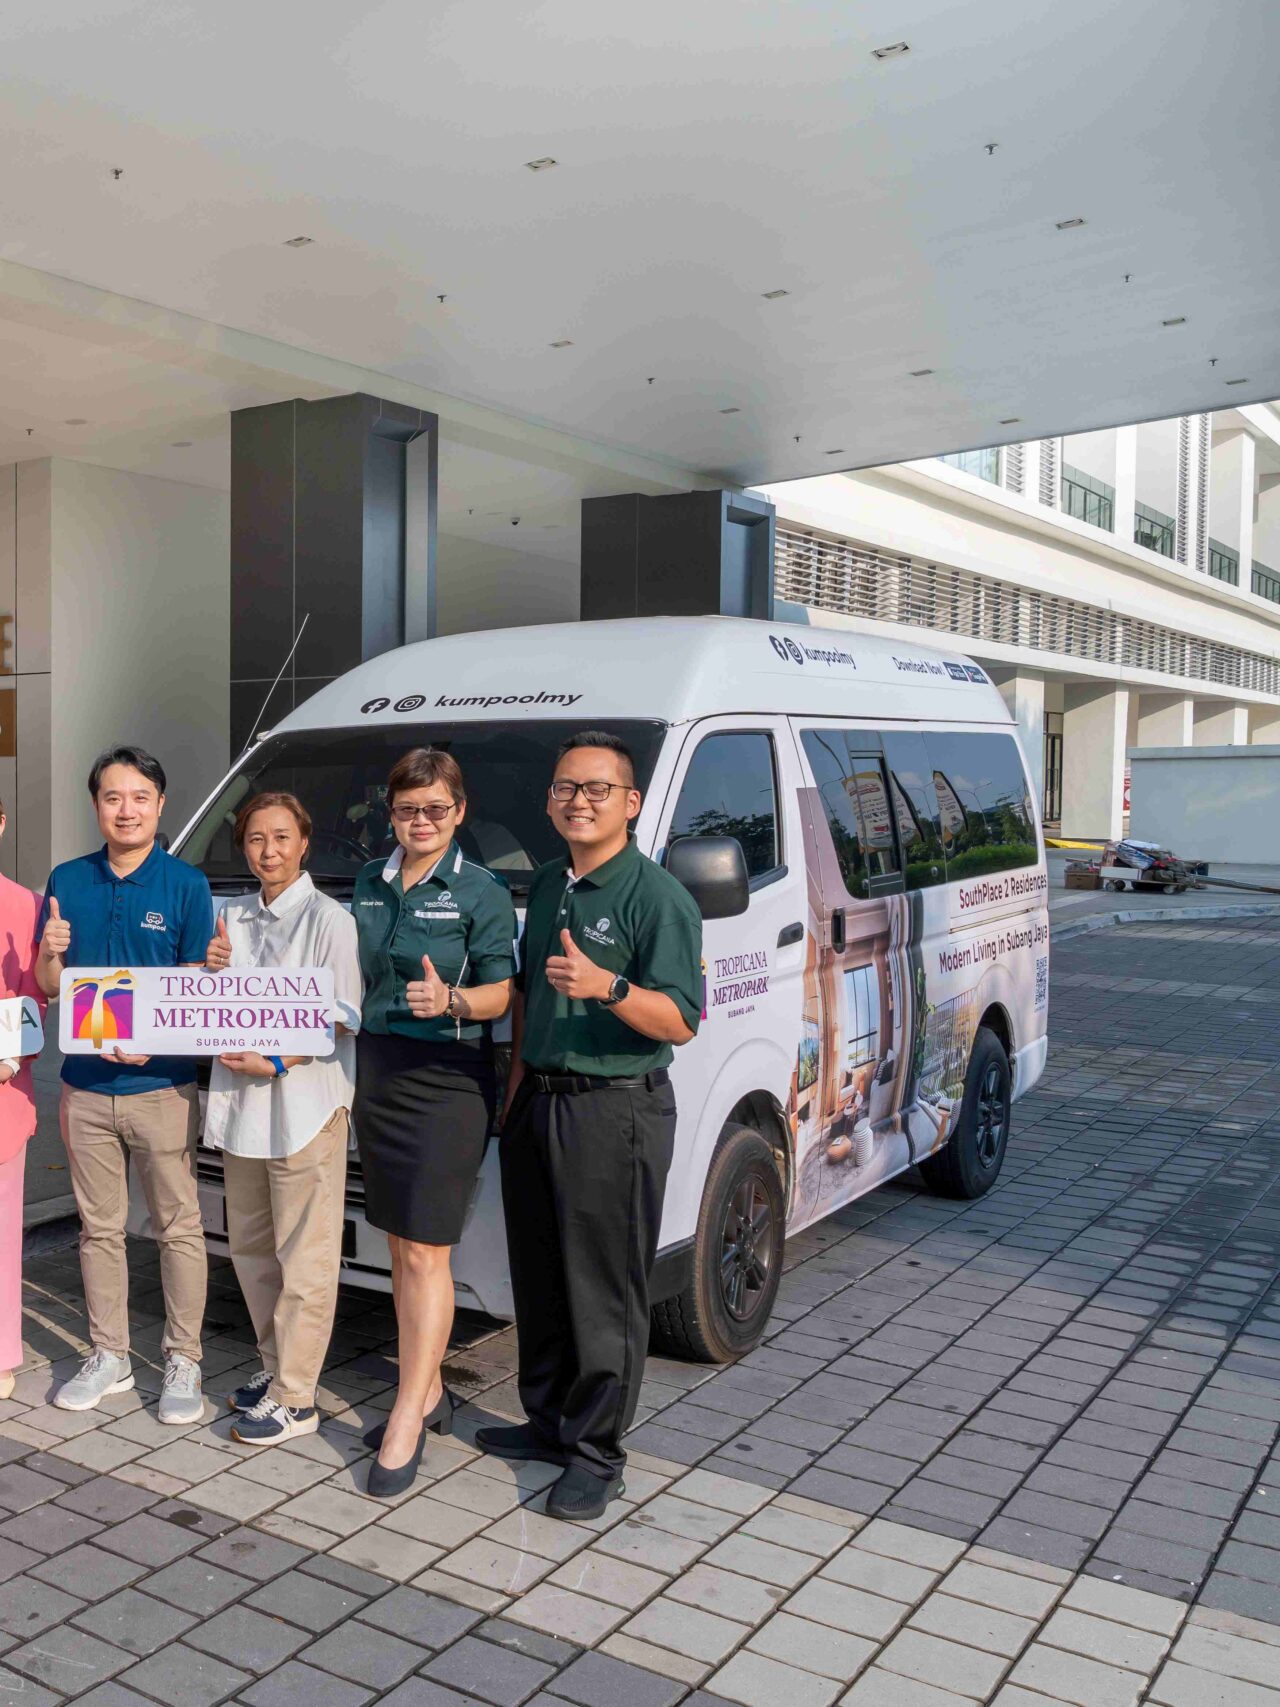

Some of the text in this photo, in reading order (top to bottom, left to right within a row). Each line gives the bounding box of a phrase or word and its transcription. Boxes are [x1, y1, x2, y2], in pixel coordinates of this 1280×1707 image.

[799, 642, 856, 670] kumpoolmy
[891, 656, 928, 674] Download
[434, 691, 583, 708] kumpoolmy
[959, 873, 1047, 909] SouthPlace 2 Residences
[424, 901, 458, 909] TROPICANA
[583, 925, 615, 945] TROPICANA
[939, 923, 1048, 974] Modern Living in Subang Jaya
[715, 951, 768, 978] TROPICANA
[160, 976, 322, 997] TROPICANA
[712, 976, 770, 1007] METROPARK
[152, 1008, 332, 1029] METROPARK
[728, 1005, 755, 1018] SUBANG JAYA
[196, 1038, 281, 1047] SUBANG JAYA
